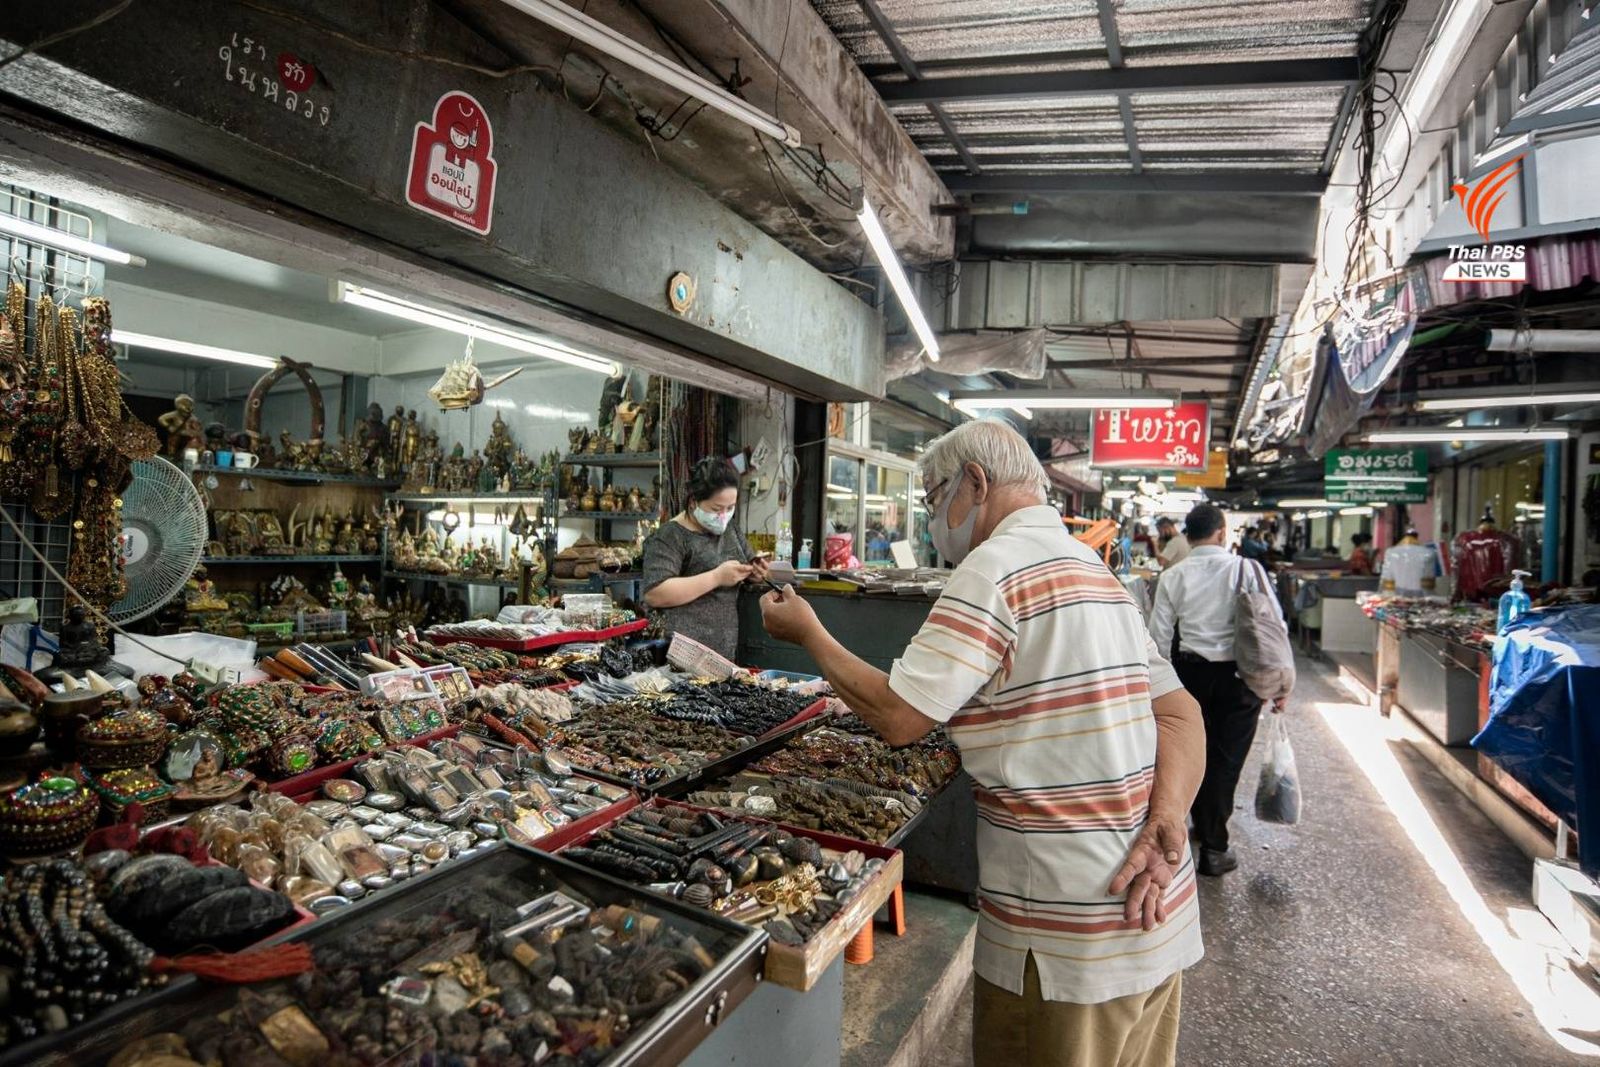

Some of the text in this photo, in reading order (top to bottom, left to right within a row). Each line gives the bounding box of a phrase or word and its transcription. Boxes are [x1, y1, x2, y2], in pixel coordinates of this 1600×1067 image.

[232, 32, 305, 83] เรา รัก
[219, 46, 329, 126] ในหลวง
[431, 173, 472, 199] ออนไลน์
[1099, 407, 1201, 444] Twin
